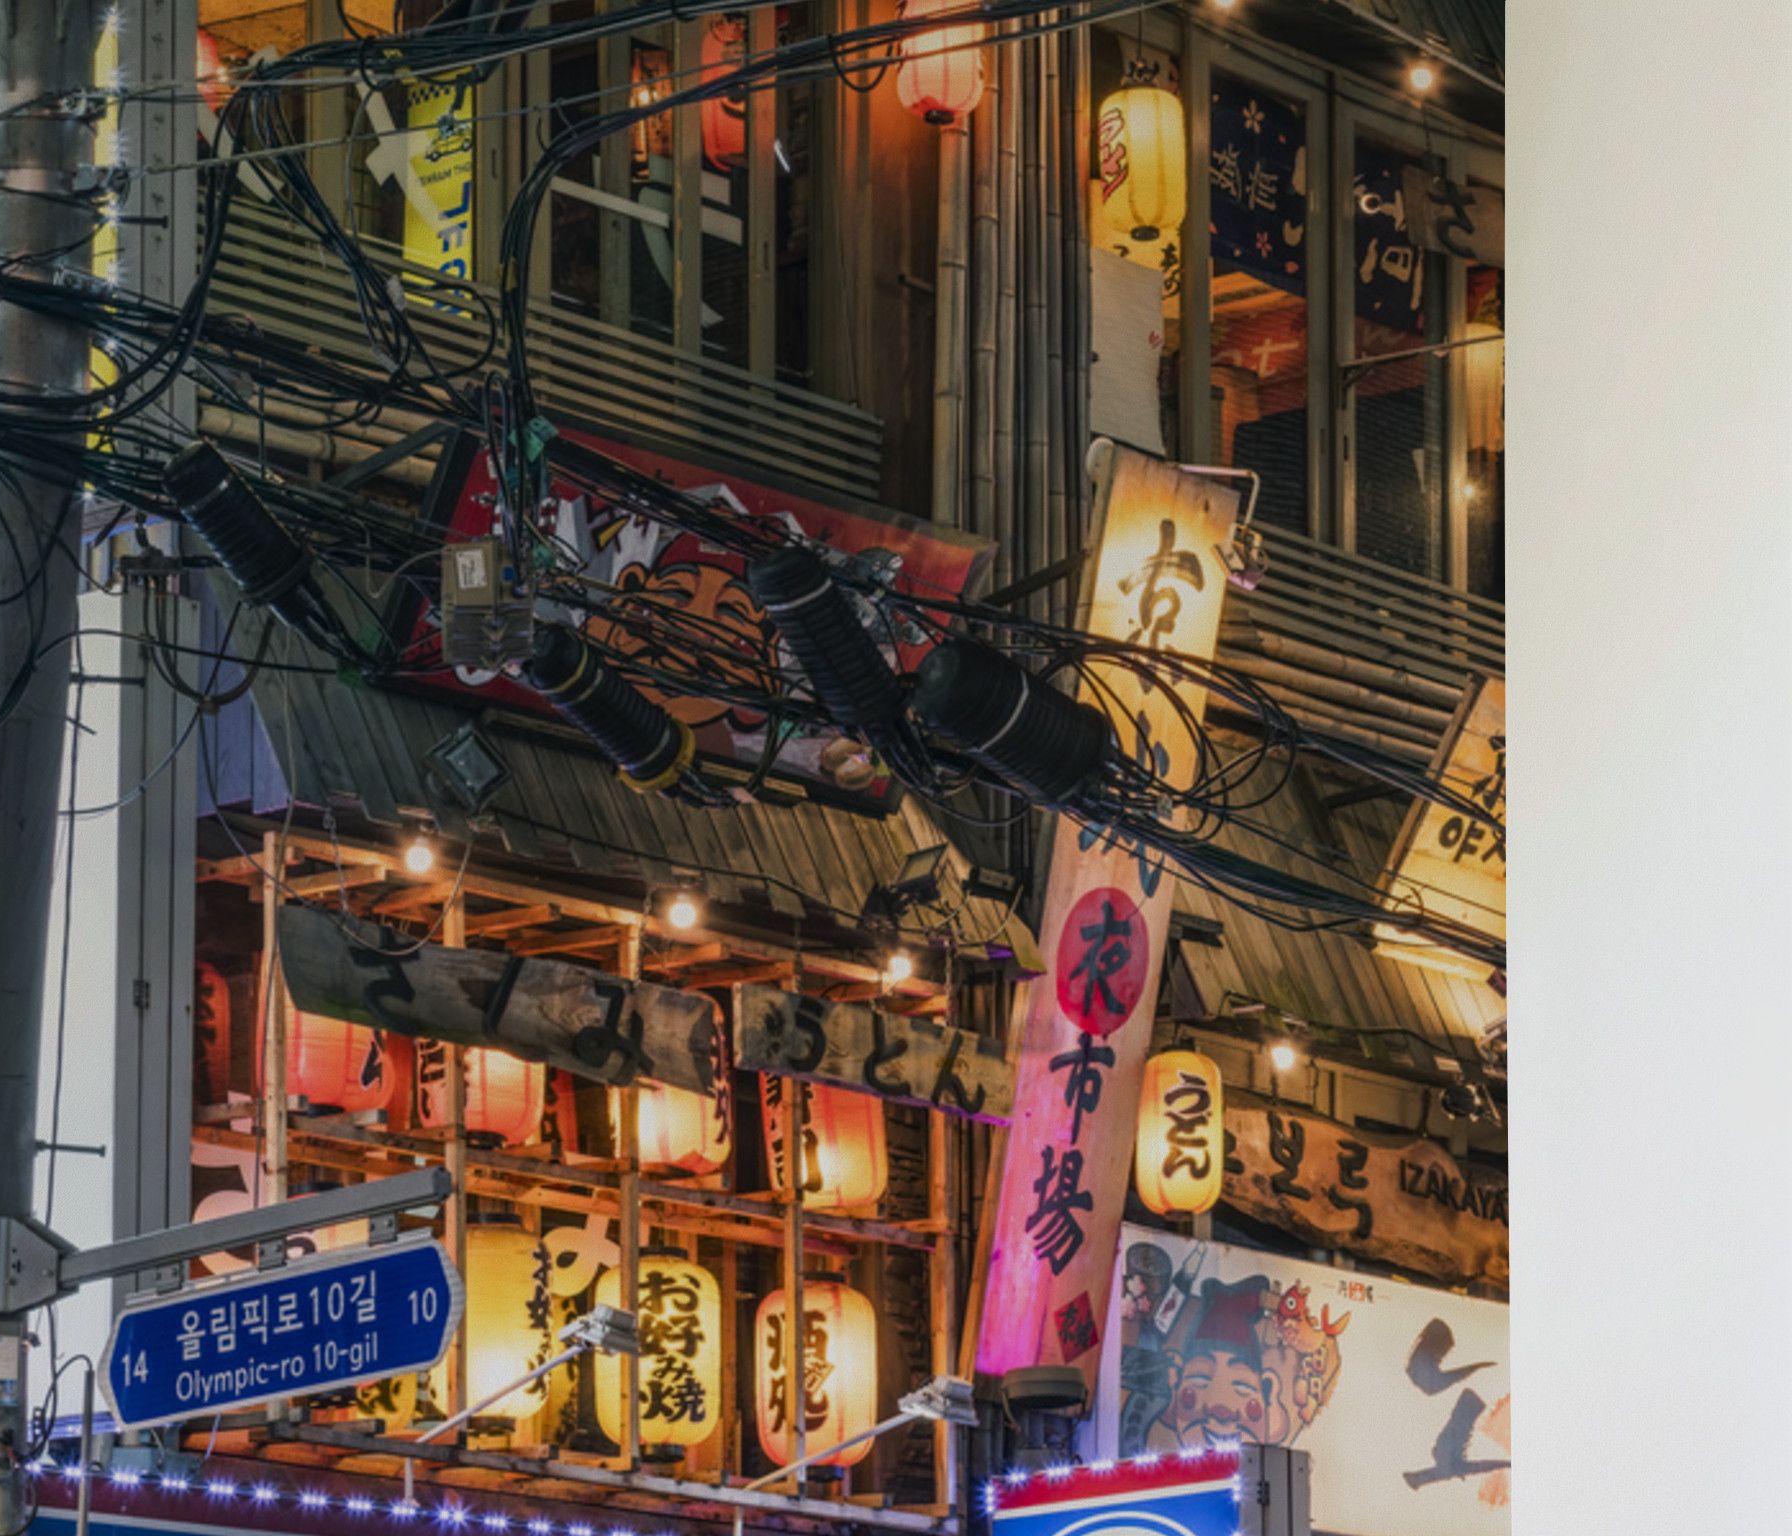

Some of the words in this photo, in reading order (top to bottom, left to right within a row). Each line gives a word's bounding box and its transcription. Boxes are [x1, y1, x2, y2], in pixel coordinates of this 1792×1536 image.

[408, 1287, 439, 1326] 10
[120, 1354, 149, 1388] 14
[174, 1352, 306, 1404] Olympic-ro
[311, 1330, 379, 1375] 10-gil
